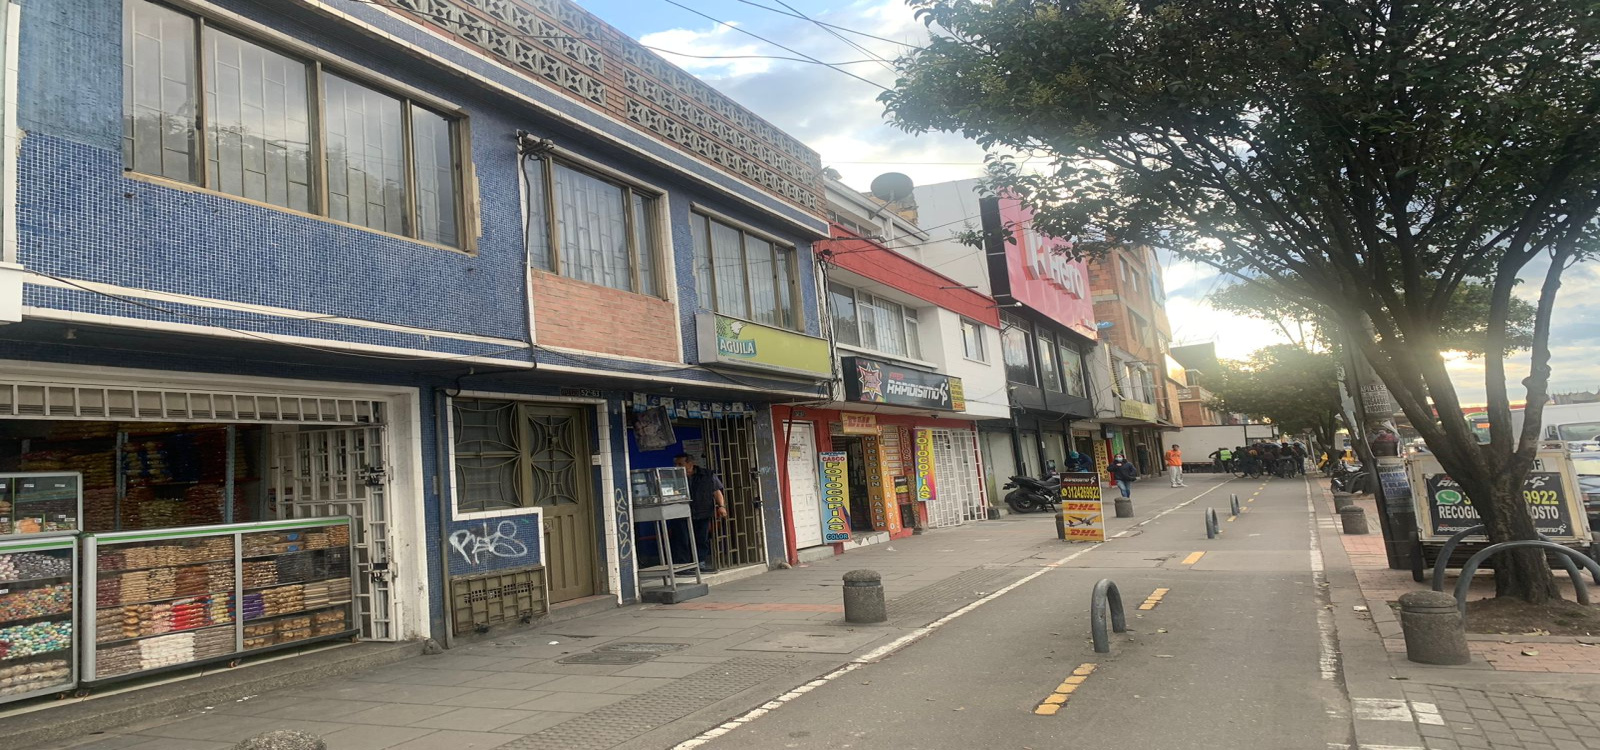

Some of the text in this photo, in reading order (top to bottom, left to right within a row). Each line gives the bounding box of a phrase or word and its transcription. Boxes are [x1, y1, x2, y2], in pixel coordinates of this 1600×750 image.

[720, 339, 755, 354] AGUILA
[887, 379, 940, 400] RAPIDISIMO
[847, 415, 873, 428] DHL
[916, 430, 931, 499] FOTOCOPIAS
[864, 435, 885, 527] MPRESION LASER
[823, 461, 845, 531] FOTOCOPIAS
[1067, 486, 1100, 499] 3124269922
[1531, 505, 1559, 519] OSTO
[826, 533, 849, 541] COLOR
